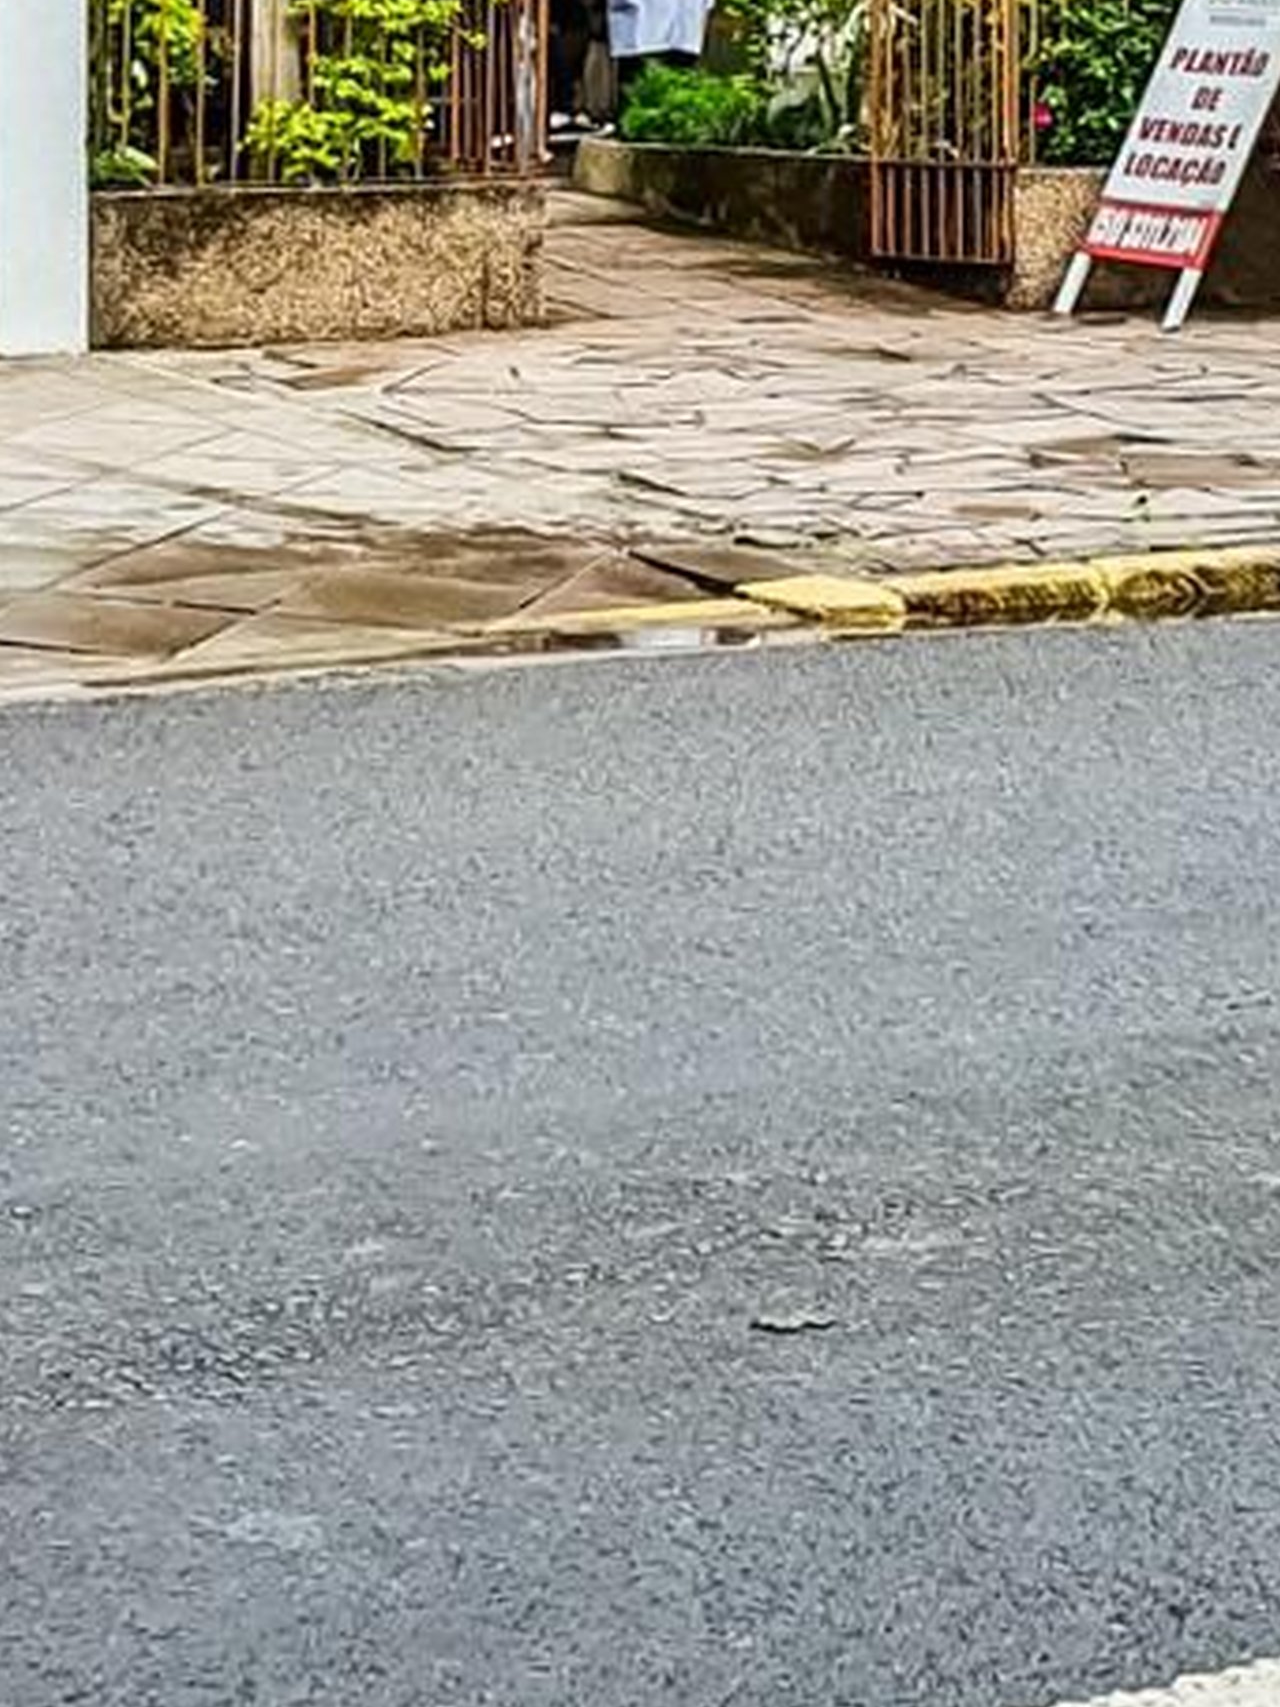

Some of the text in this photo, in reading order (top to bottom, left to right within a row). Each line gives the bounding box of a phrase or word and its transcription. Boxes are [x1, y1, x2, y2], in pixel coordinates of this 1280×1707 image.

[1170, 47, 1270, 77] PLANTÃO
[1190, 86, 1224, 112] DE
[1138, 117, 1226, 147] VENDAS
[1123, 151, 1227, 187] LOCAÇÃO
